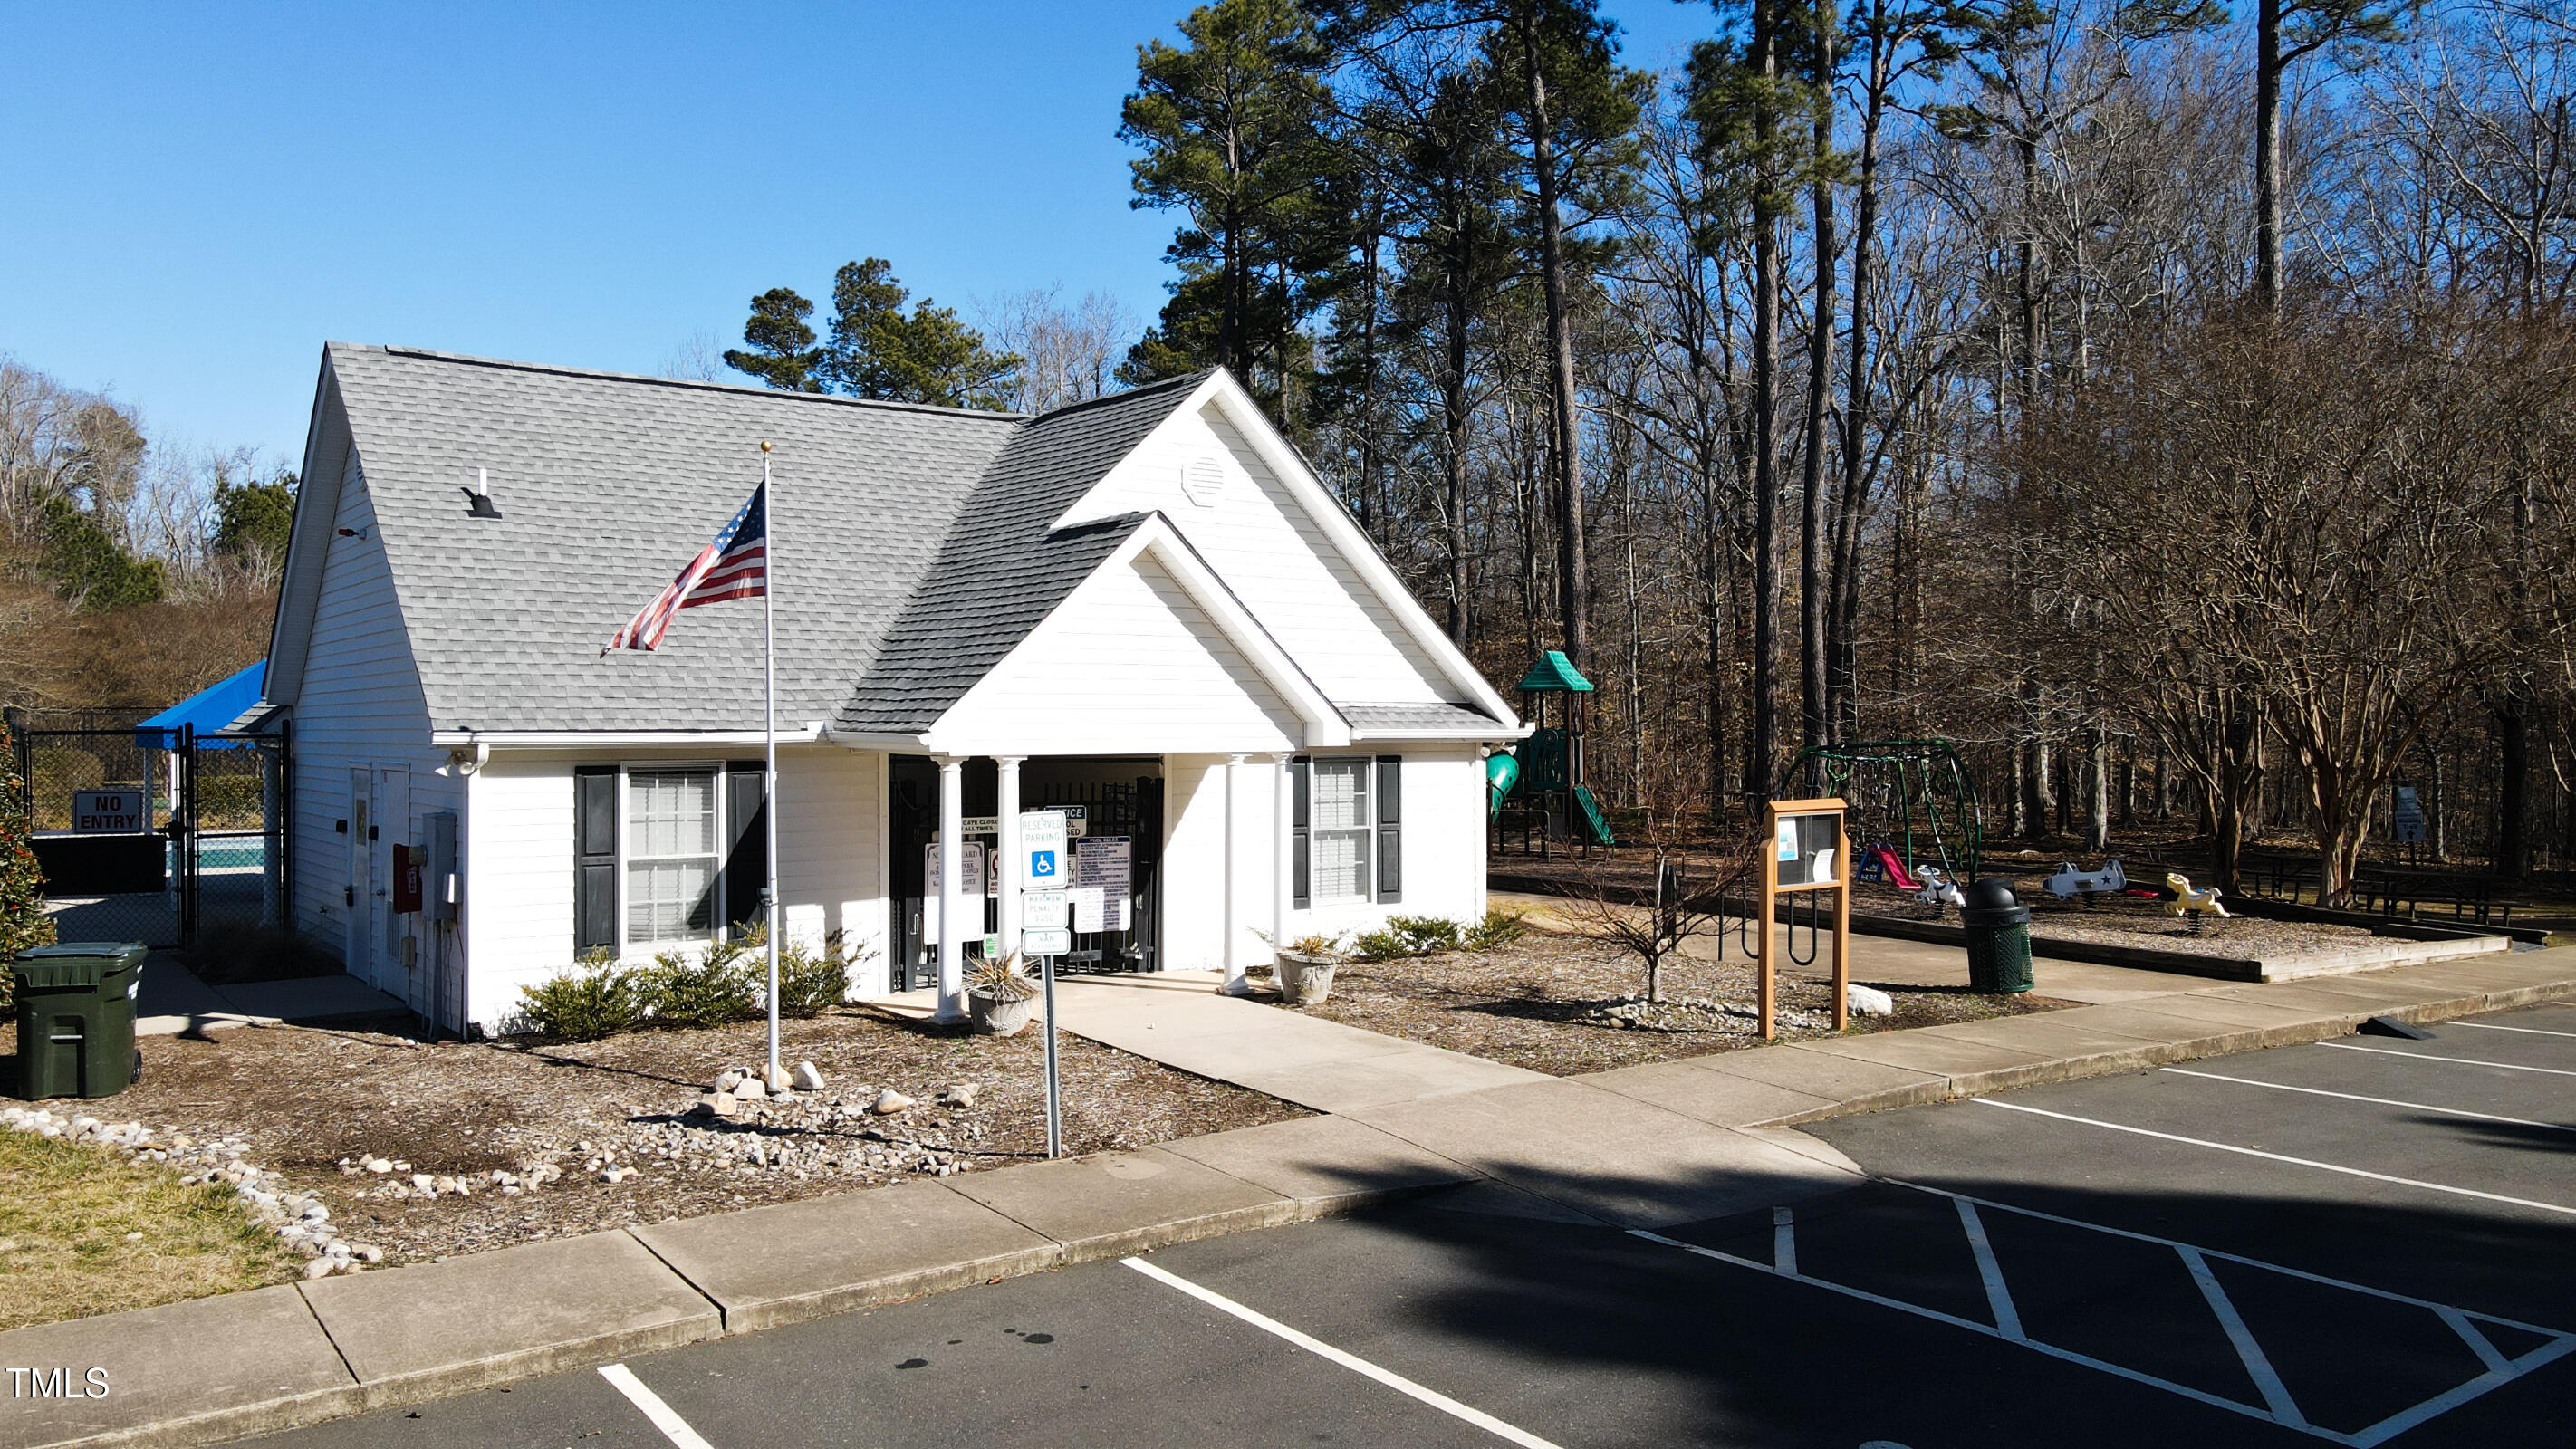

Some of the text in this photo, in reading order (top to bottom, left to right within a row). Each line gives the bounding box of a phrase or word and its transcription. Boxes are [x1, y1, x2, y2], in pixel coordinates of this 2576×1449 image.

[95, 796, 122, 811] NO
[81, 815, 136, 829] ENTRY
[1022, 819, 1062, 830] RESERVED
[1025, 832, 1060, 842] PARKING
[1029, 895, 1061, 903] MAXIMUM
[1029, 904, 1059, 913] PENALTY
[1039, 934, 1055, 943] VAN
